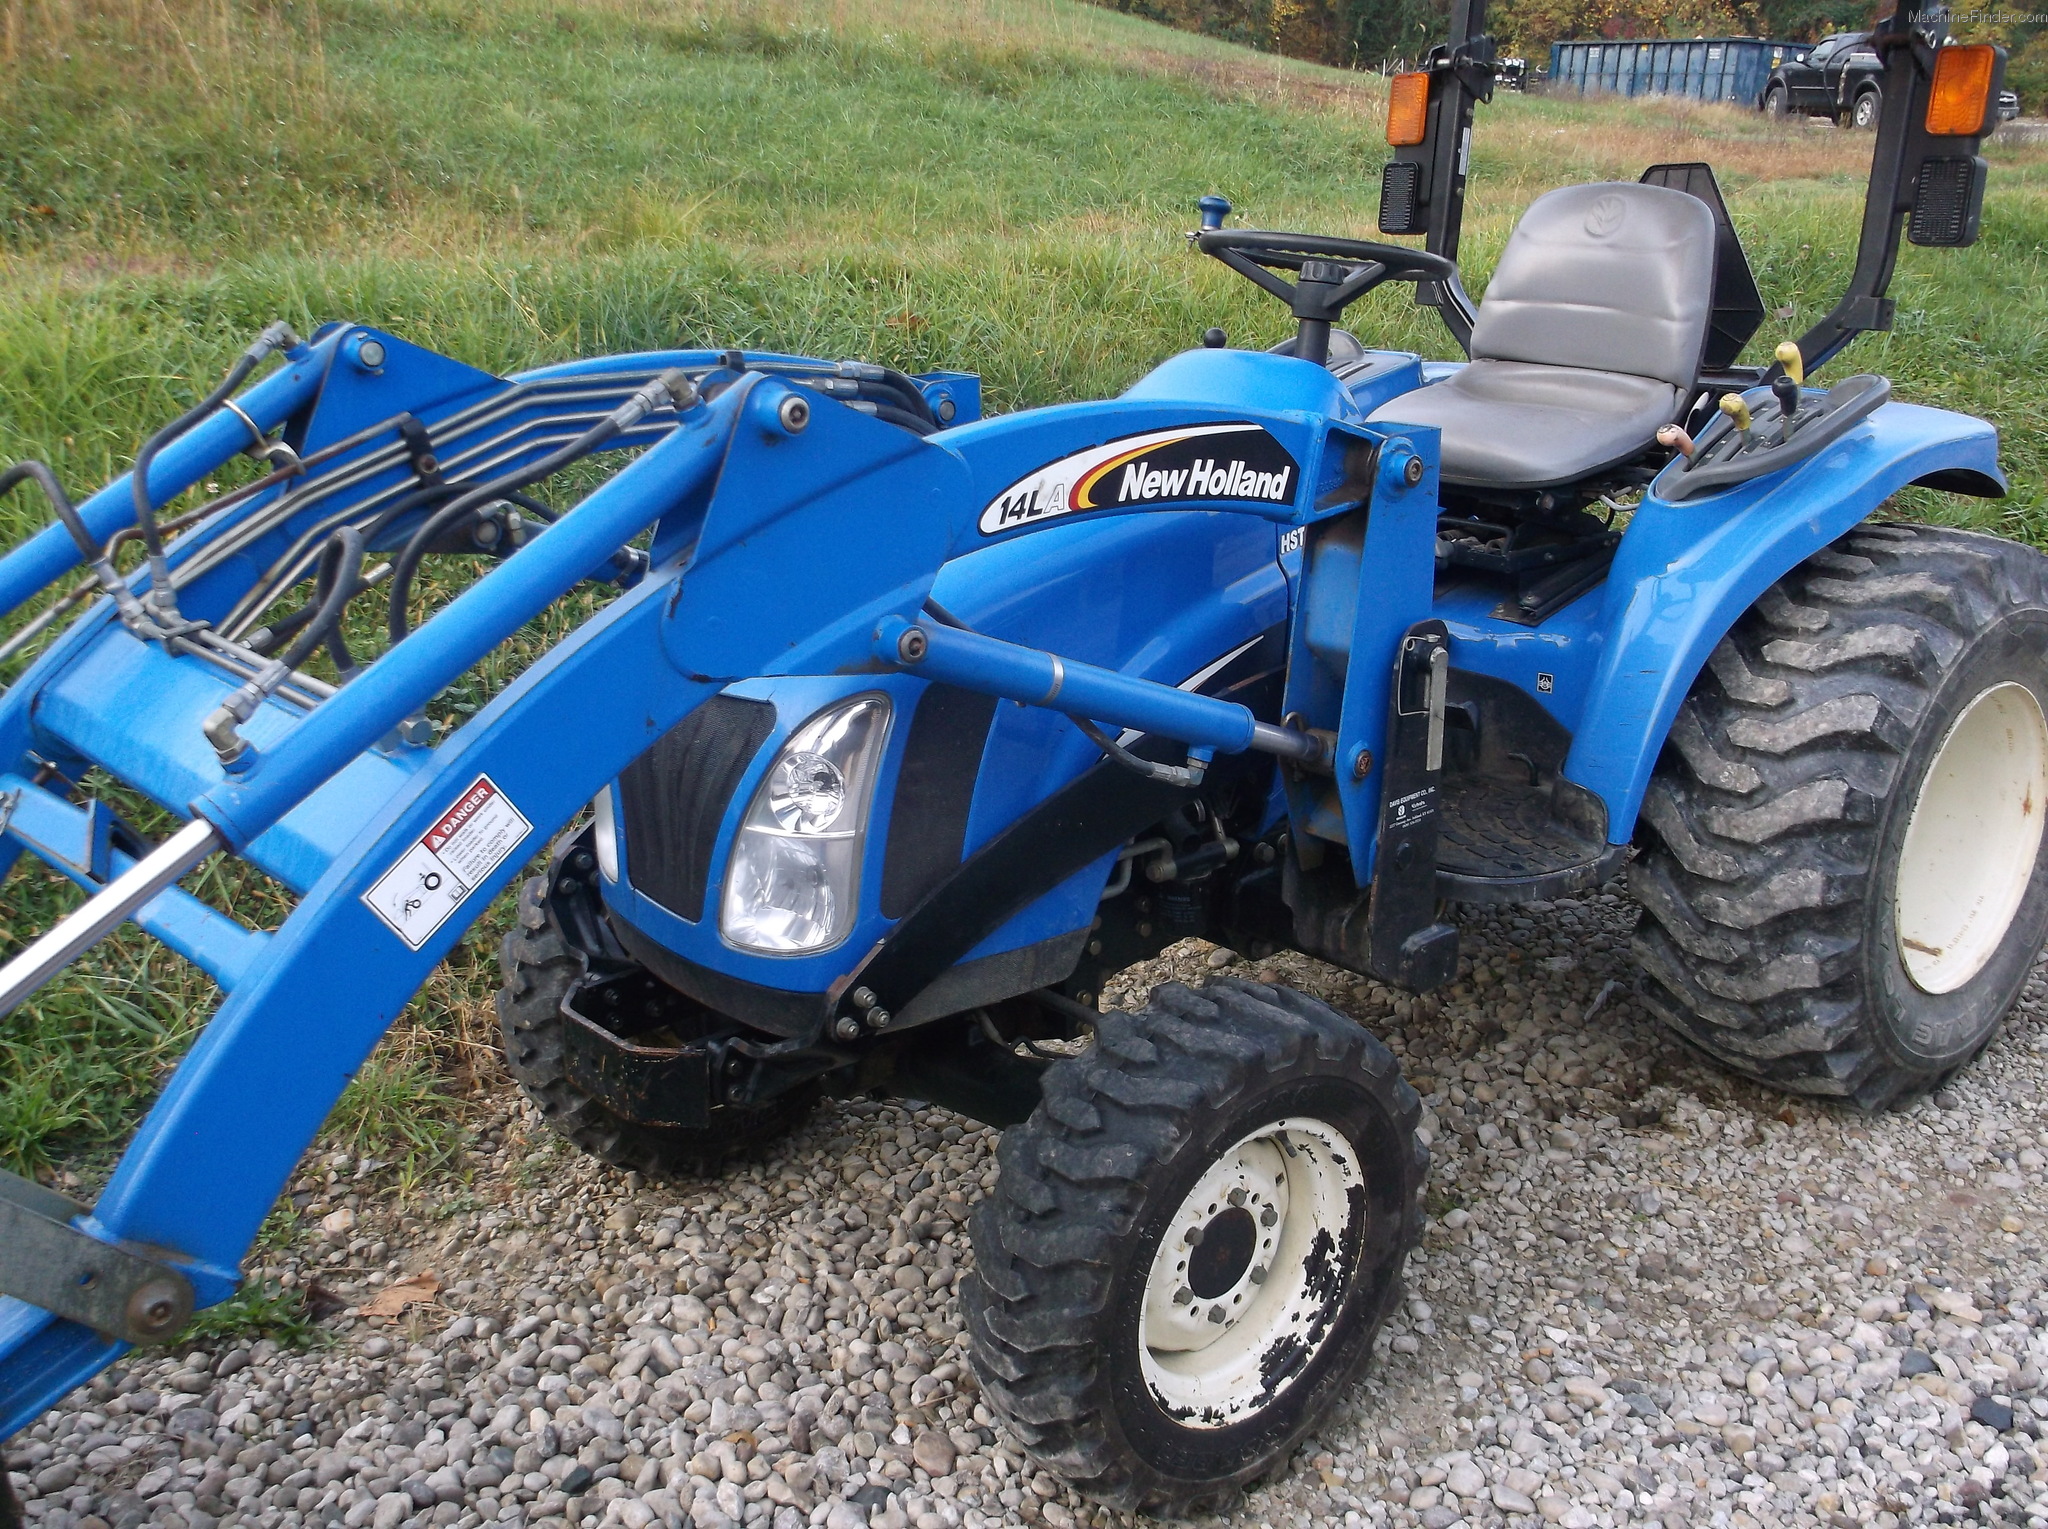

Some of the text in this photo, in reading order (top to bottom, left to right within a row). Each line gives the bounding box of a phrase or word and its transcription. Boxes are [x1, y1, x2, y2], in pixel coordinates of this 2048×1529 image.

[1118, 459, 1291, 502] New Holland
[999, 484, 1065, 525] 14LA
[1281, 526, 1305, 554] HST
[442, 787, 489, 835] DANGER
[485, 827, 505, 848] comply
[487, 838, 503, 855] death
[470, 860, 490, 881] serious
